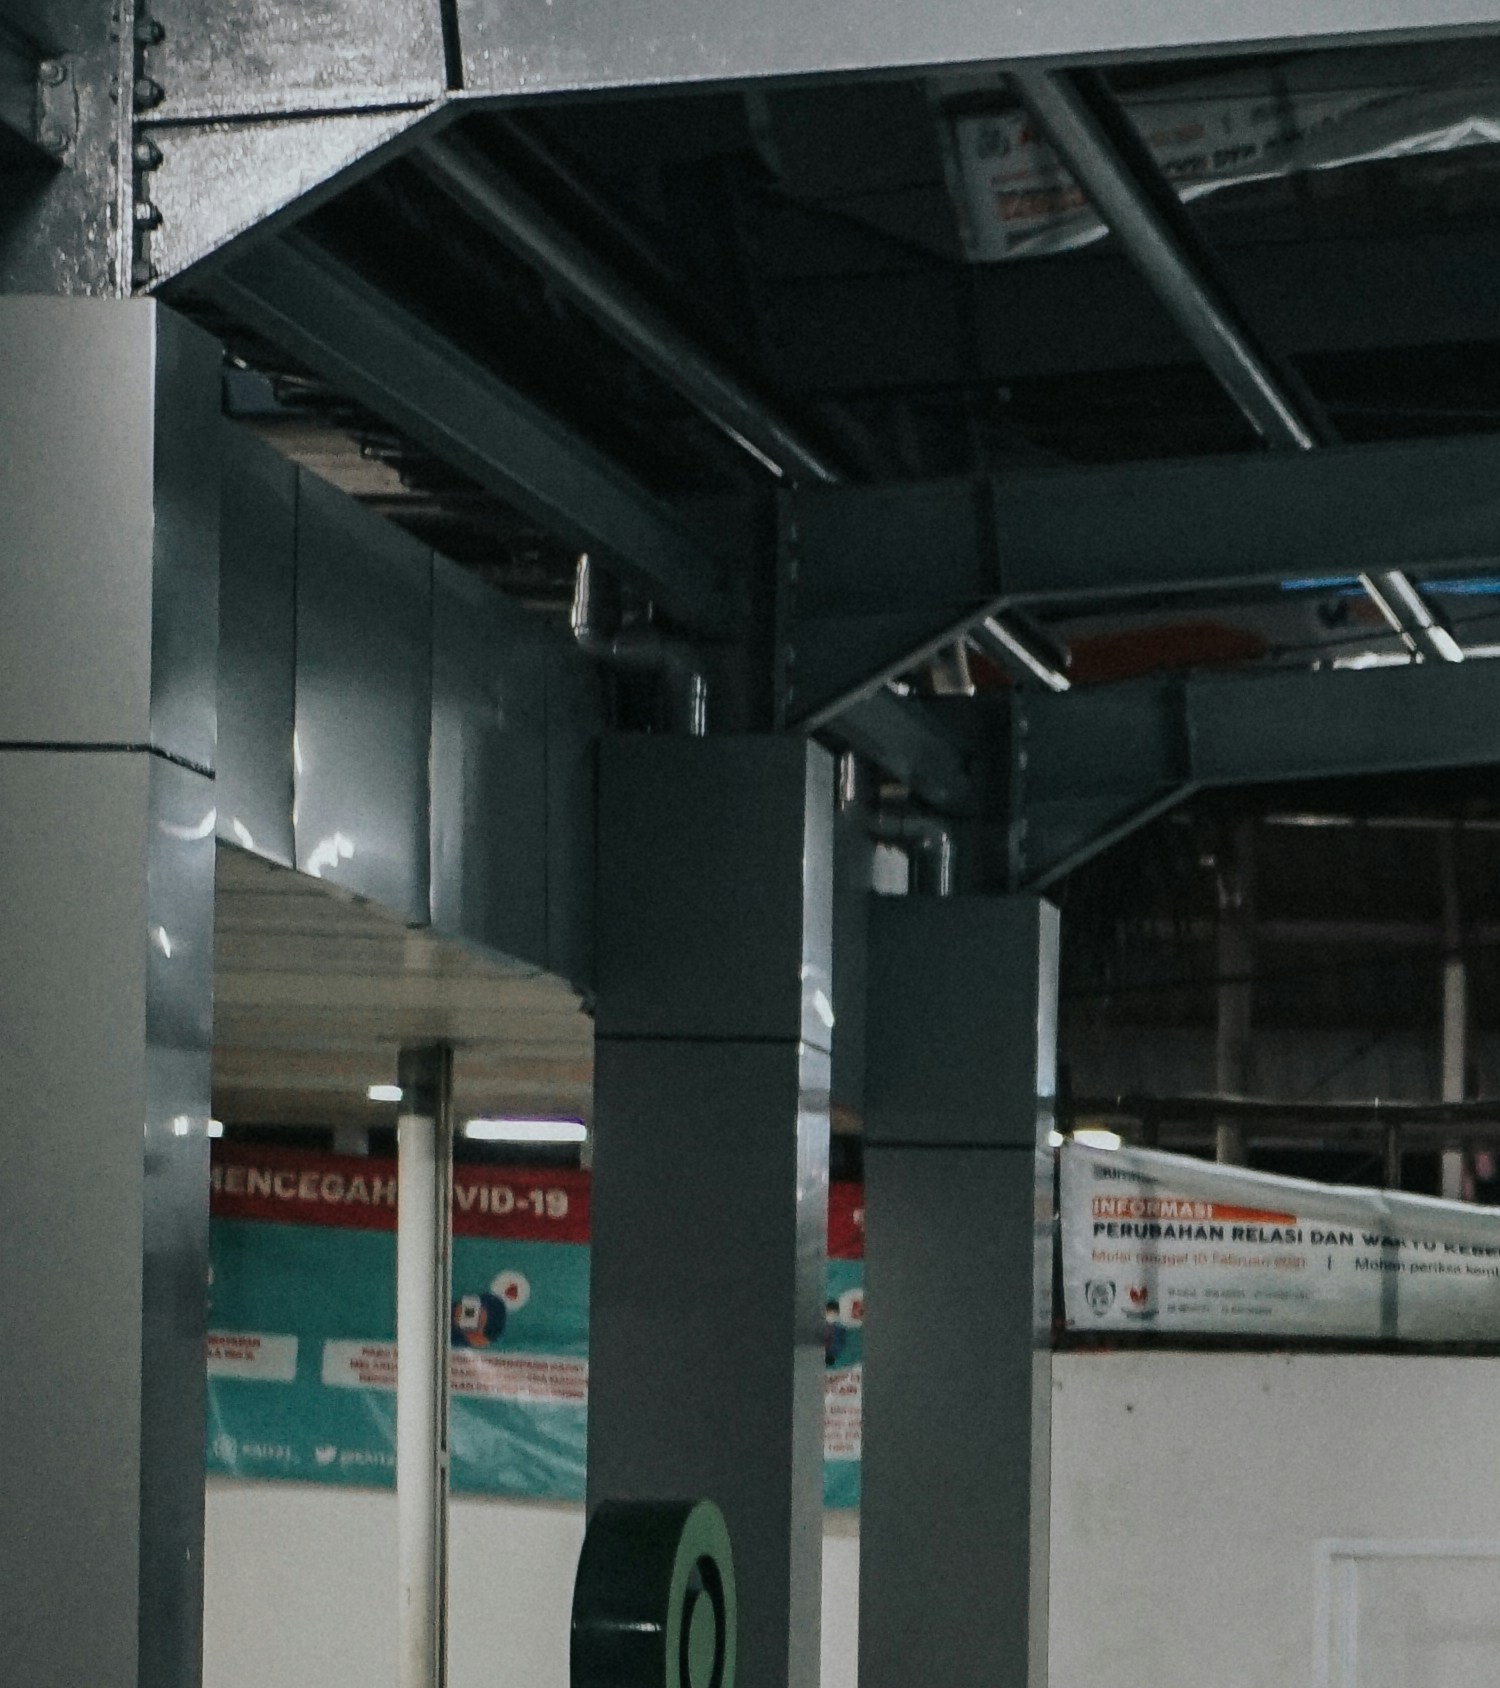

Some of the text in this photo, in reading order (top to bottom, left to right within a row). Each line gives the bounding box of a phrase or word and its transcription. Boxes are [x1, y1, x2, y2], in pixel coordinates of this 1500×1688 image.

[453, 1183, 570, 1219] VID-19
[1093, 1198, 1213, 1219] INFORMASI
[1093, 1222, 1224, 1241] PERUBAHAN
[1231, 1226, 1303, 1244] RELASI
[1309, 1229, 1355, 1247] DAN
[1361, 1232, 1437, 1251] WAKTU
